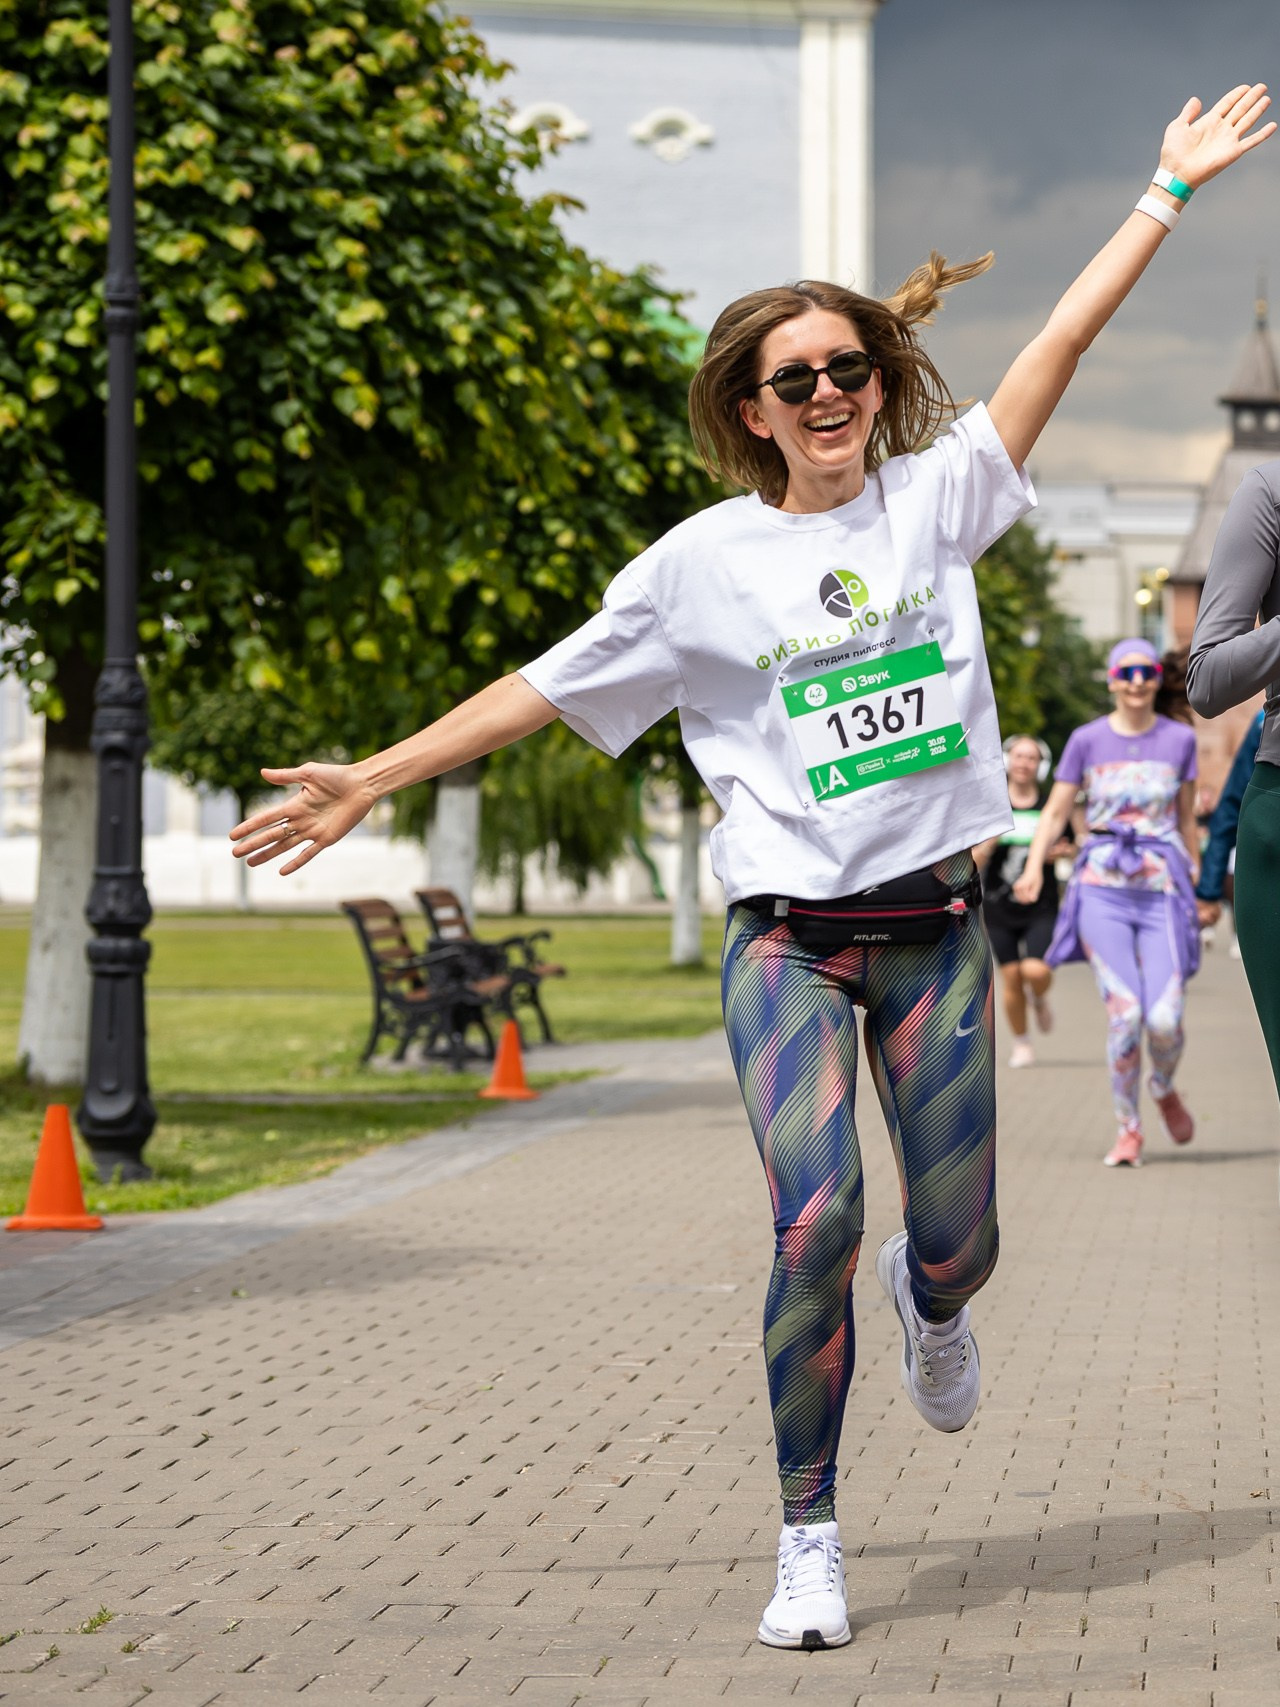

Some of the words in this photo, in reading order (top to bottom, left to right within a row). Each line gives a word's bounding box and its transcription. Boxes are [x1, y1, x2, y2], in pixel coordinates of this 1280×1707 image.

[814, 652, 850, 668] студия
[858, 671, 891, 688] Звук
[809, 687, 823, 699] 4,2
[827, 686, 924, 749] 1367
[927, 736, 946, 747] 30.05
[930, 745, 947, 756] 2026
